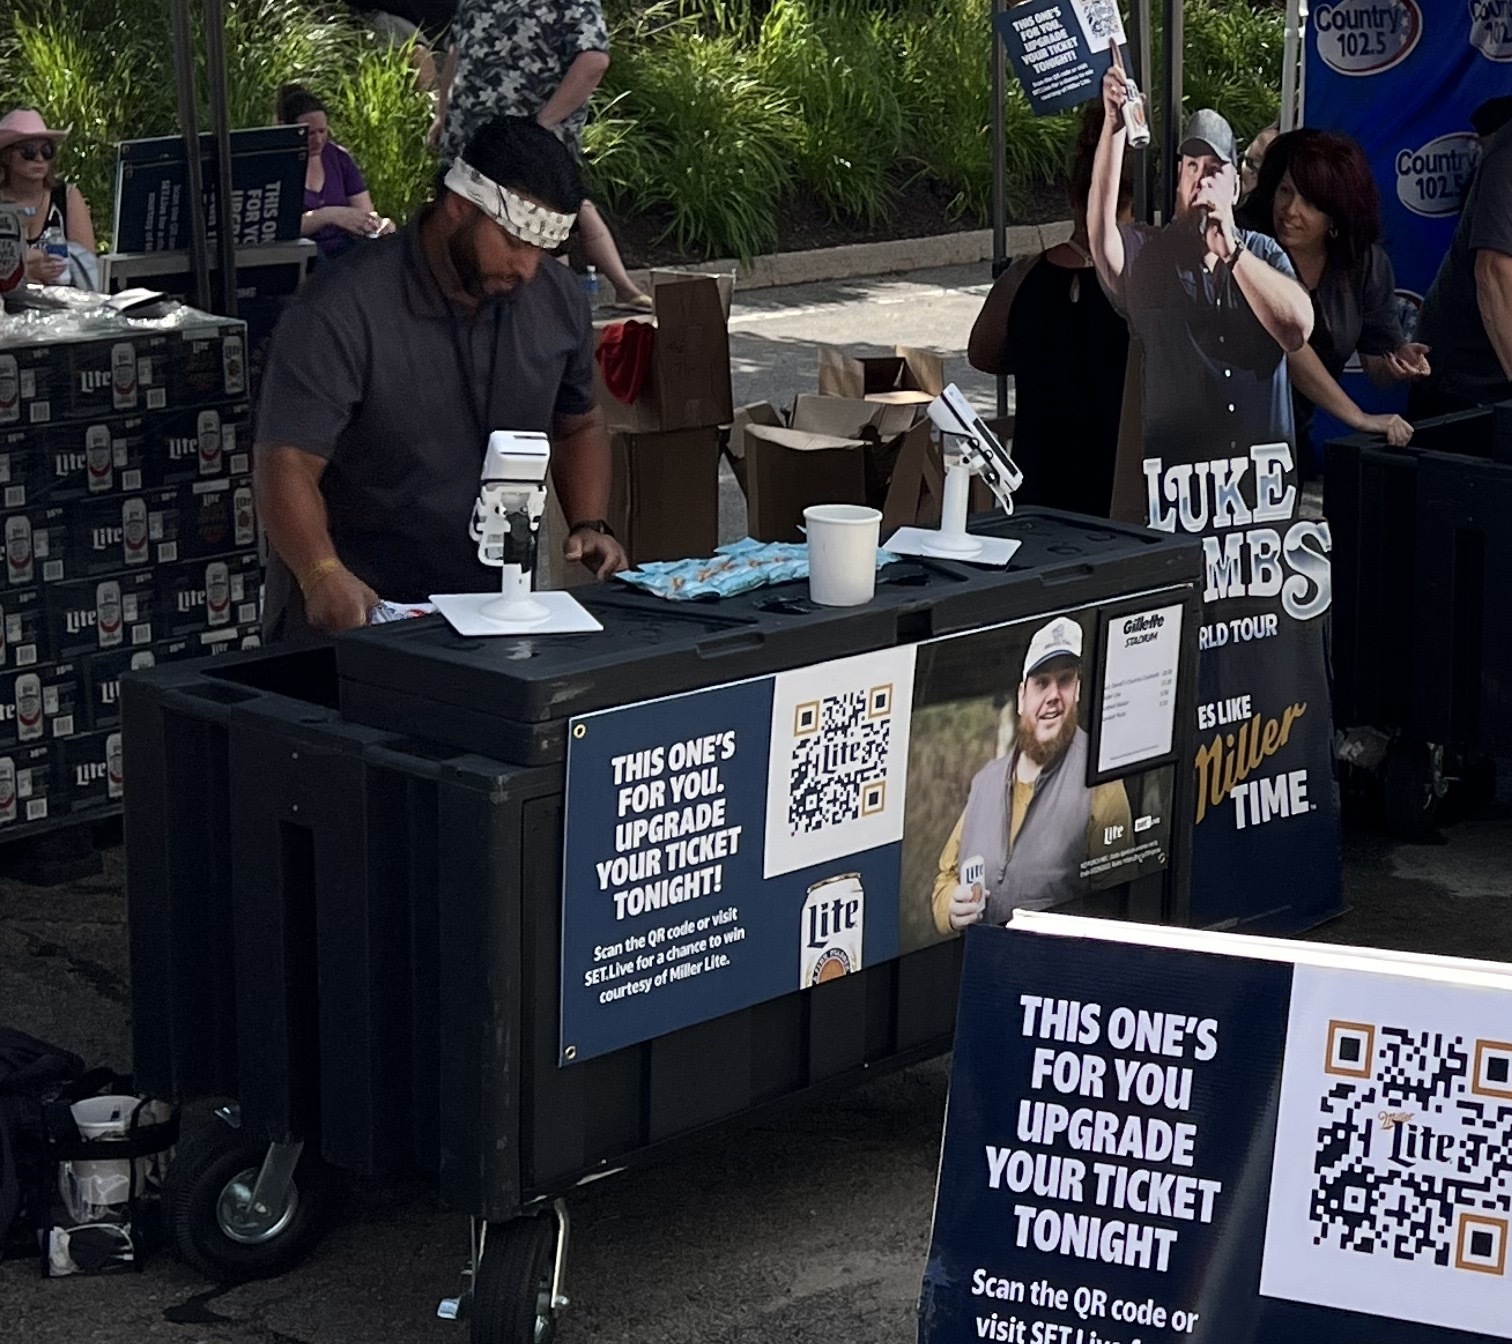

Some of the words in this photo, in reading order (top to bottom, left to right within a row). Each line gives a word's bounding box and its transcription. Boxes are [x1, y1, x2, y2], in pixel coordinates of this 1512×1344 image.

[1316, 5, 1399, 33] Country
[1338, 31, 1386, 56] 102.5
[80, 369, 111, 393] Lite
[169, 438, 197, 460] Lite
[1143, 441, 1297, 533] LUKE
[1202, 520, 1333, 621] MBS
[66, 610, 97, 633] Lite
[1123, 613, 1165, 635] Gillette
[1199, 623, 1228, 651] RLD
[1230, 613, 1279, 644] TOUR
[101, 681, 120, 703] Li
[1217, 694, 1252, 723] LIKE
[611, 746, 665, 785] THIS
[668, 730, 735, 772] ONE'S
[821, 740, 861, 775] Lite
[617, 780, 666, 817] FOR
[669, 767, 725, 803] YOU.
[1230, 769, 1310, 829] TIME
[615, 798, 726, 852] UPGRADE
[596, 848, 662, 890] YOUR
[665, 826, 742, 871] TICKET
[966, 863, 984, 885] Lite
[613, 864, 723, 920] TONIGHT!
[594, 942, 623, 962] Scan
[625, 933, 646, 954] the
[648, 927, 666, 947] QR
[667, 919, 695, 940] code
[696, 916, 710, 932] or
[711, 907, 738, 927] visit
[807, 898, 859, 949] Lite
[584, 960, 634, 987] SET.Live
[636, 951, 655, 971] for
[656, 951, 665, 964] a
[666, 941, 707, 962] chance
[709, 933, 722, 950] to
[723, 926, 745, 945] win
[599, 976, 652, 1004] courtesy
[654, 969, 670, 987] of
[669, 960, 703, 983] Miller
[704, 953, 730, 973] Lite.
[1020, 994, 1101, 1044] THIS
[1107, 1007, 1218, 1061] ONE'S
[1031, 1047, 1106, 1098] FOR
[1114, 1058, 1193, 1111] YOU
[1016, 1099, 1197, 1167] UPGRADE
[1388, 1119, 1455, 1168] Lite
[985, 1145, 1086, 1202] YOUR
[1093, 1162, 1222, 1224] TICKET
[1014, 1204, 1178, 1272] TONIGHT
[971, 1268, 1025, 1303] Scan
[1030, 1280, 1069, 1310] the
[1073, 1287, 1108, 1319] QR
[1111, 1299, 1167, 1328] code
[1171, 1309, 1200, 1333] or
[975, 1312, 1027, 1344] visit
